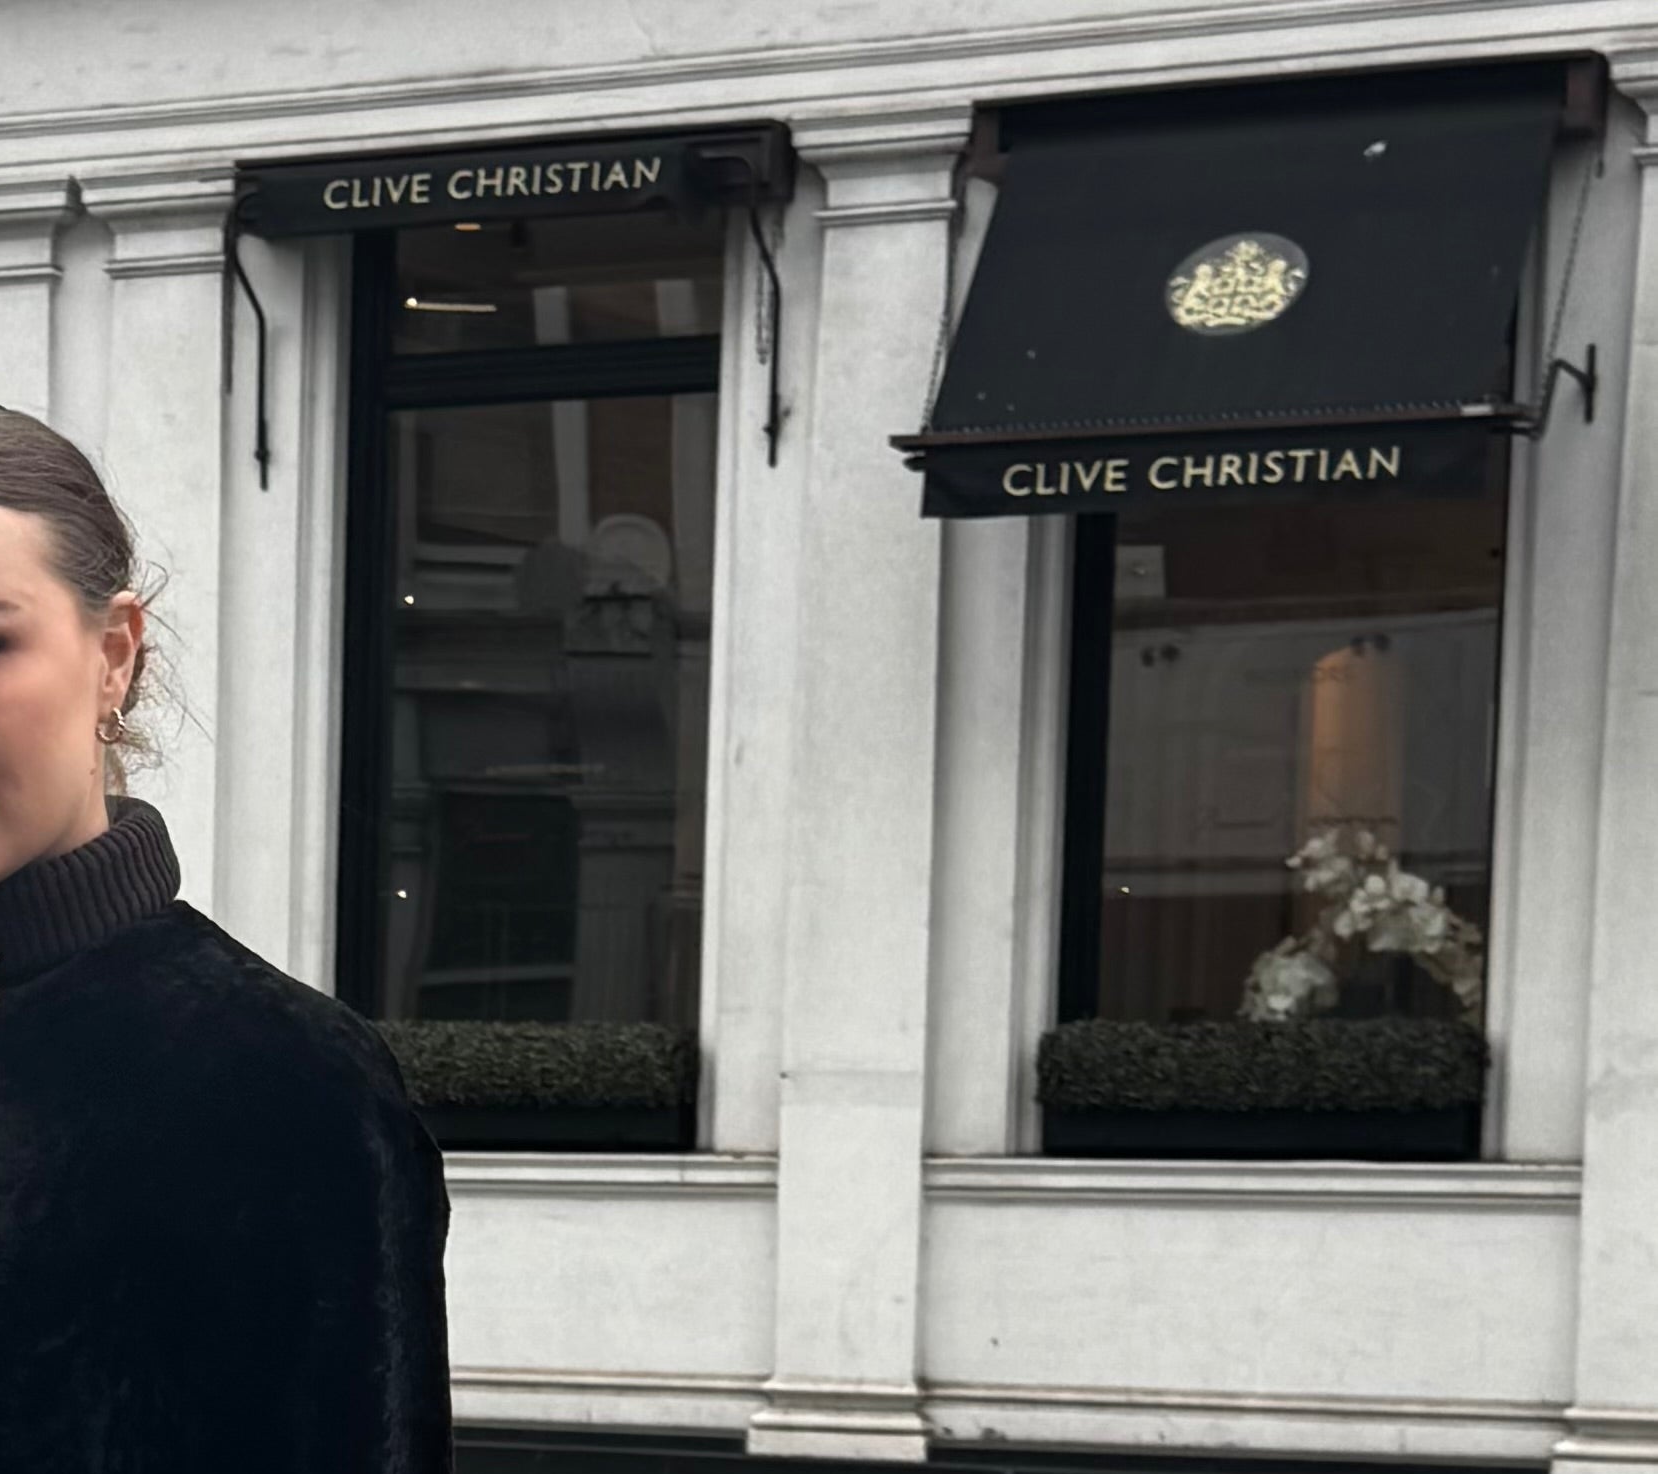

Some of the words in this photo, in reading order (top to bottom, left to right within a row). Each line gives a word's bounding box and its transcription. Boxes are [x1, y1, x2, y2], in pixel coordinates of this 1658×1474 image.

[323, 173, 432, 210] CLIVE
[446, 156, 661, 200] CHRISTIAN
[1001, 458, 1130, 497] CLIVE
[1147, 445, 1402, 490] CHRISTIAN
